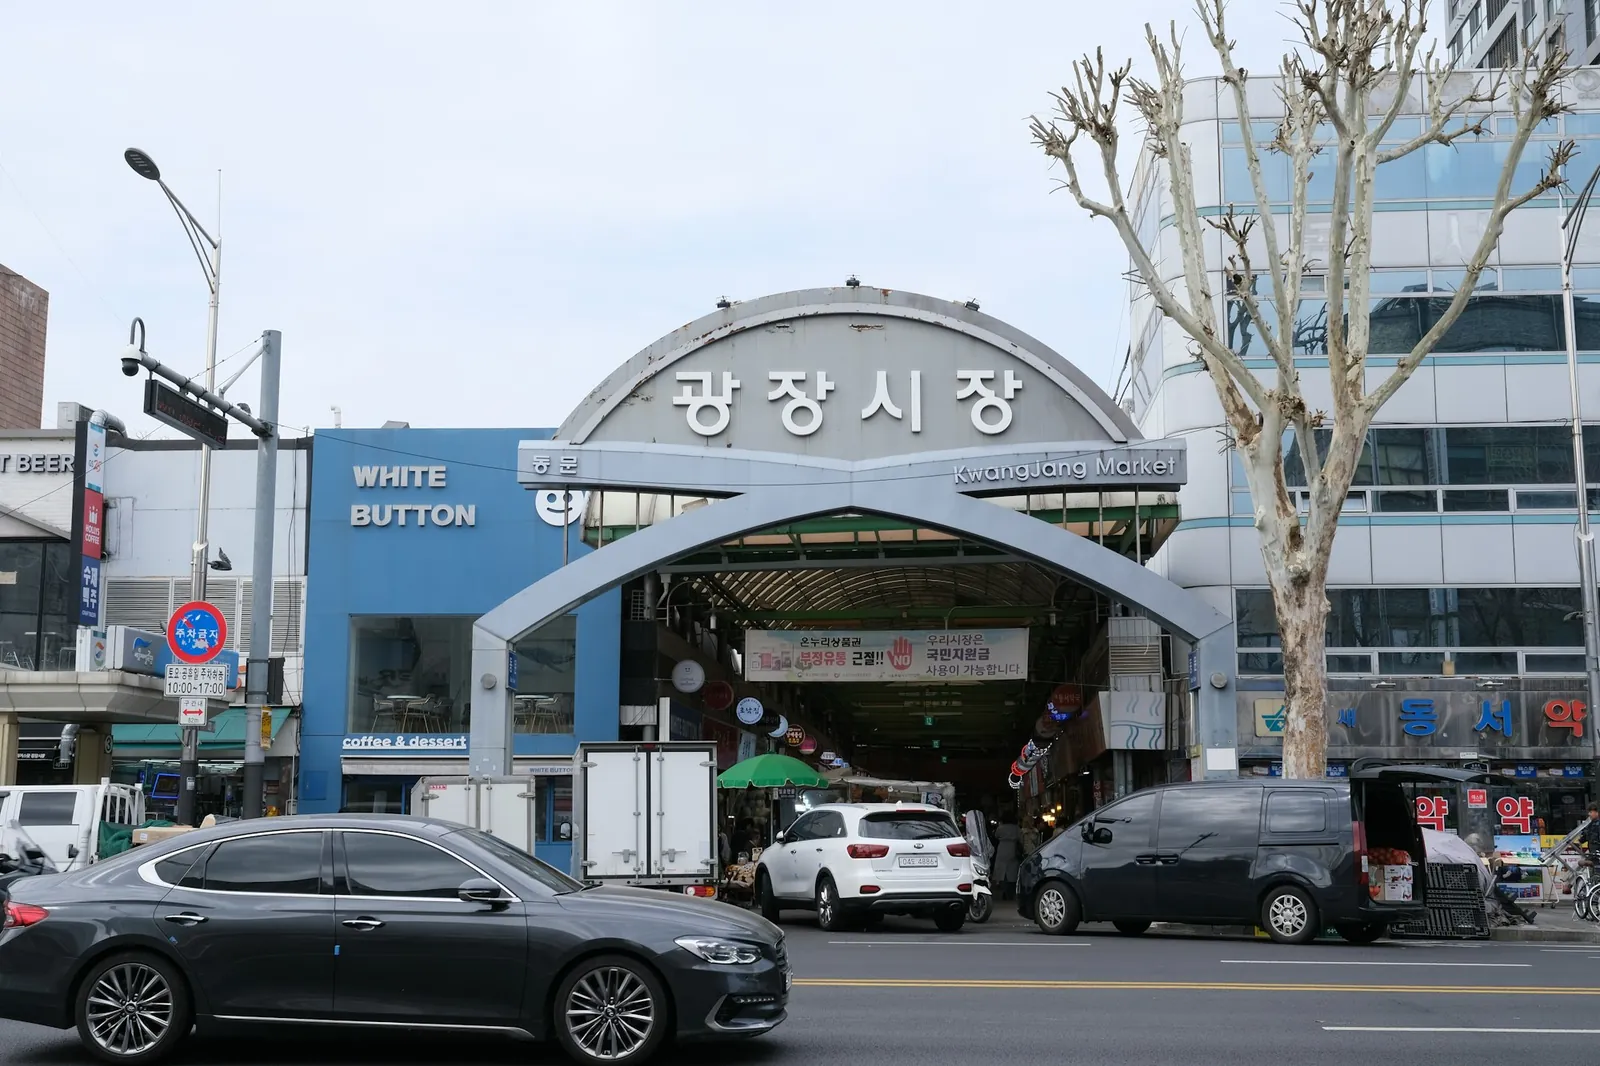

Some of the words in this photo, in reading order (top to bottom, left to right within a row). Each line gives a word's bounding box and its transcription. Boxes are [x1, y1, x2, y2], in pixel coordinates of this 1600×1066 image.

[672, 370, 1023, 436] 광장시장
[16, 453, 75, 473] BEER
[532, 455, 578, 475] 동문
[1096, 456, 1176, 476] Market
[353, 465, 447, 488] WHITE
[350, 504, 476, 527] BUTTON
[85, 533, 100, 545] COFFEE
[175, 628, 218, 639] 주차금지
[926, 633, 985, 646] 우리시장은
[800, 637, 861, 648] 온누리상품권
[800, 651, 847, 666] 부정유통
[852, 651, 884, 666] 근절!!
[893, 655, 911, 666] NO
[926, 648, 990, 662] 국민지원금
[926, 664, 960, 677] 사용이
[167, 682, 224, 694] 10:00~17:00
[342, 735, 392, 748] coffee
[395, 735, 406, 748] &
[409, 735, 467, 748] dessert
[1496, 796, 1535, 834] 약
